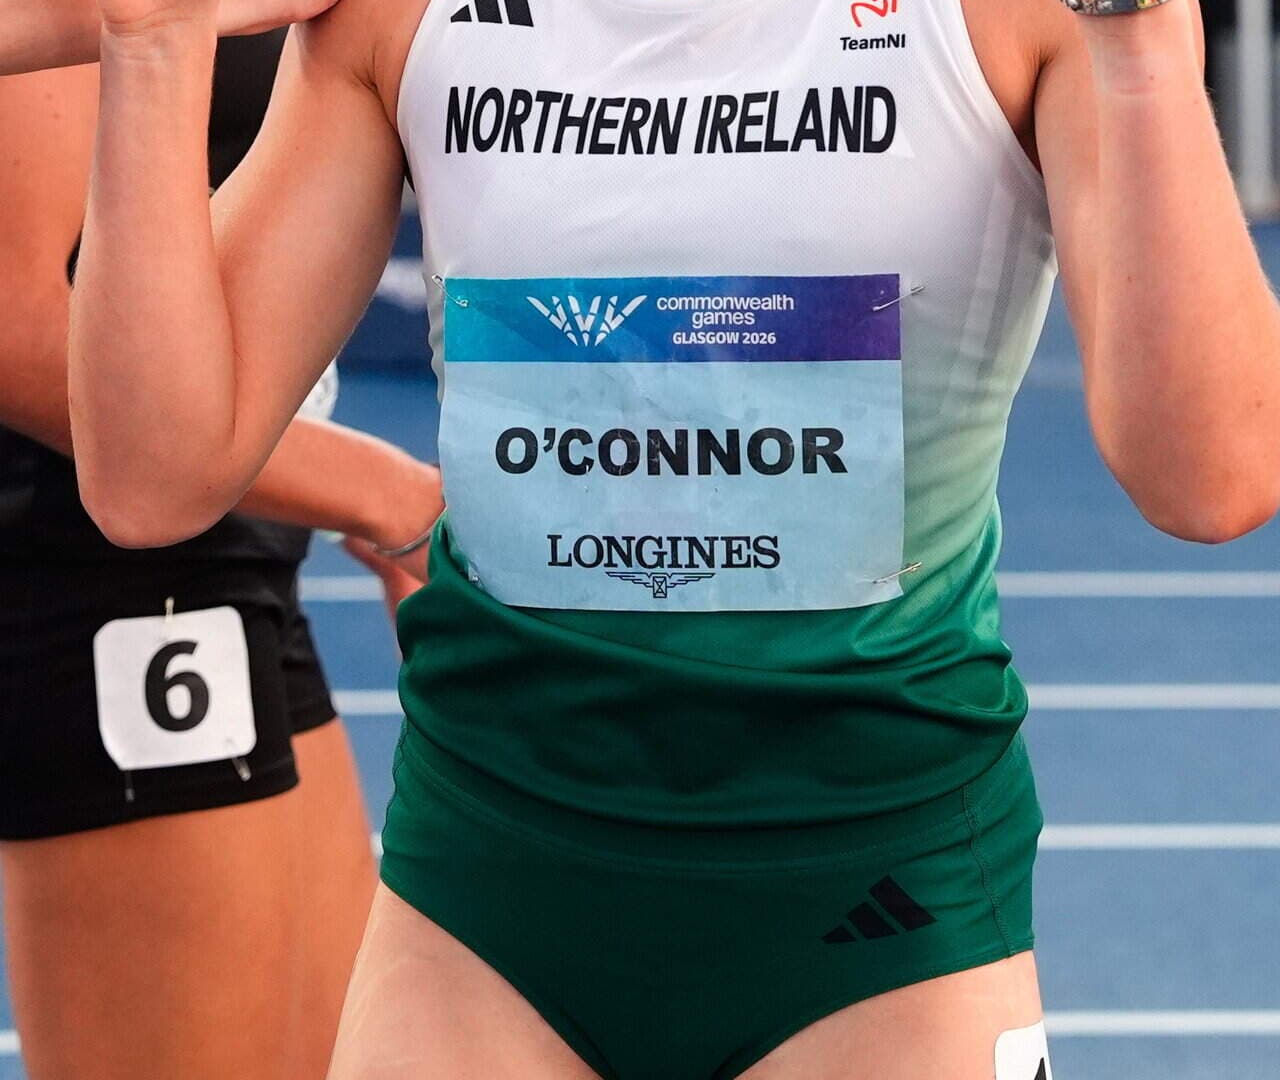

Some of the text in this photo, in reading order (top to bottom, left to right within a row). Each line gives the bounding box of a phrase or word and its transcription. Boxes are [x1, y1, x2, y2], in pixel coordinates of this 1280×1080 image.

[839, 33, 906, 51] TeamNI
[444, 85, 897, 155] NORTHERN IRELAND
[656, 294, 795, 312] commonwealth
[691, 310, 756, 326] games
[672, 331, 777, 345] GLASGOW 2026
[546, 534, 781, 570] LONGINES
[144, 640, 210, 732] 6
